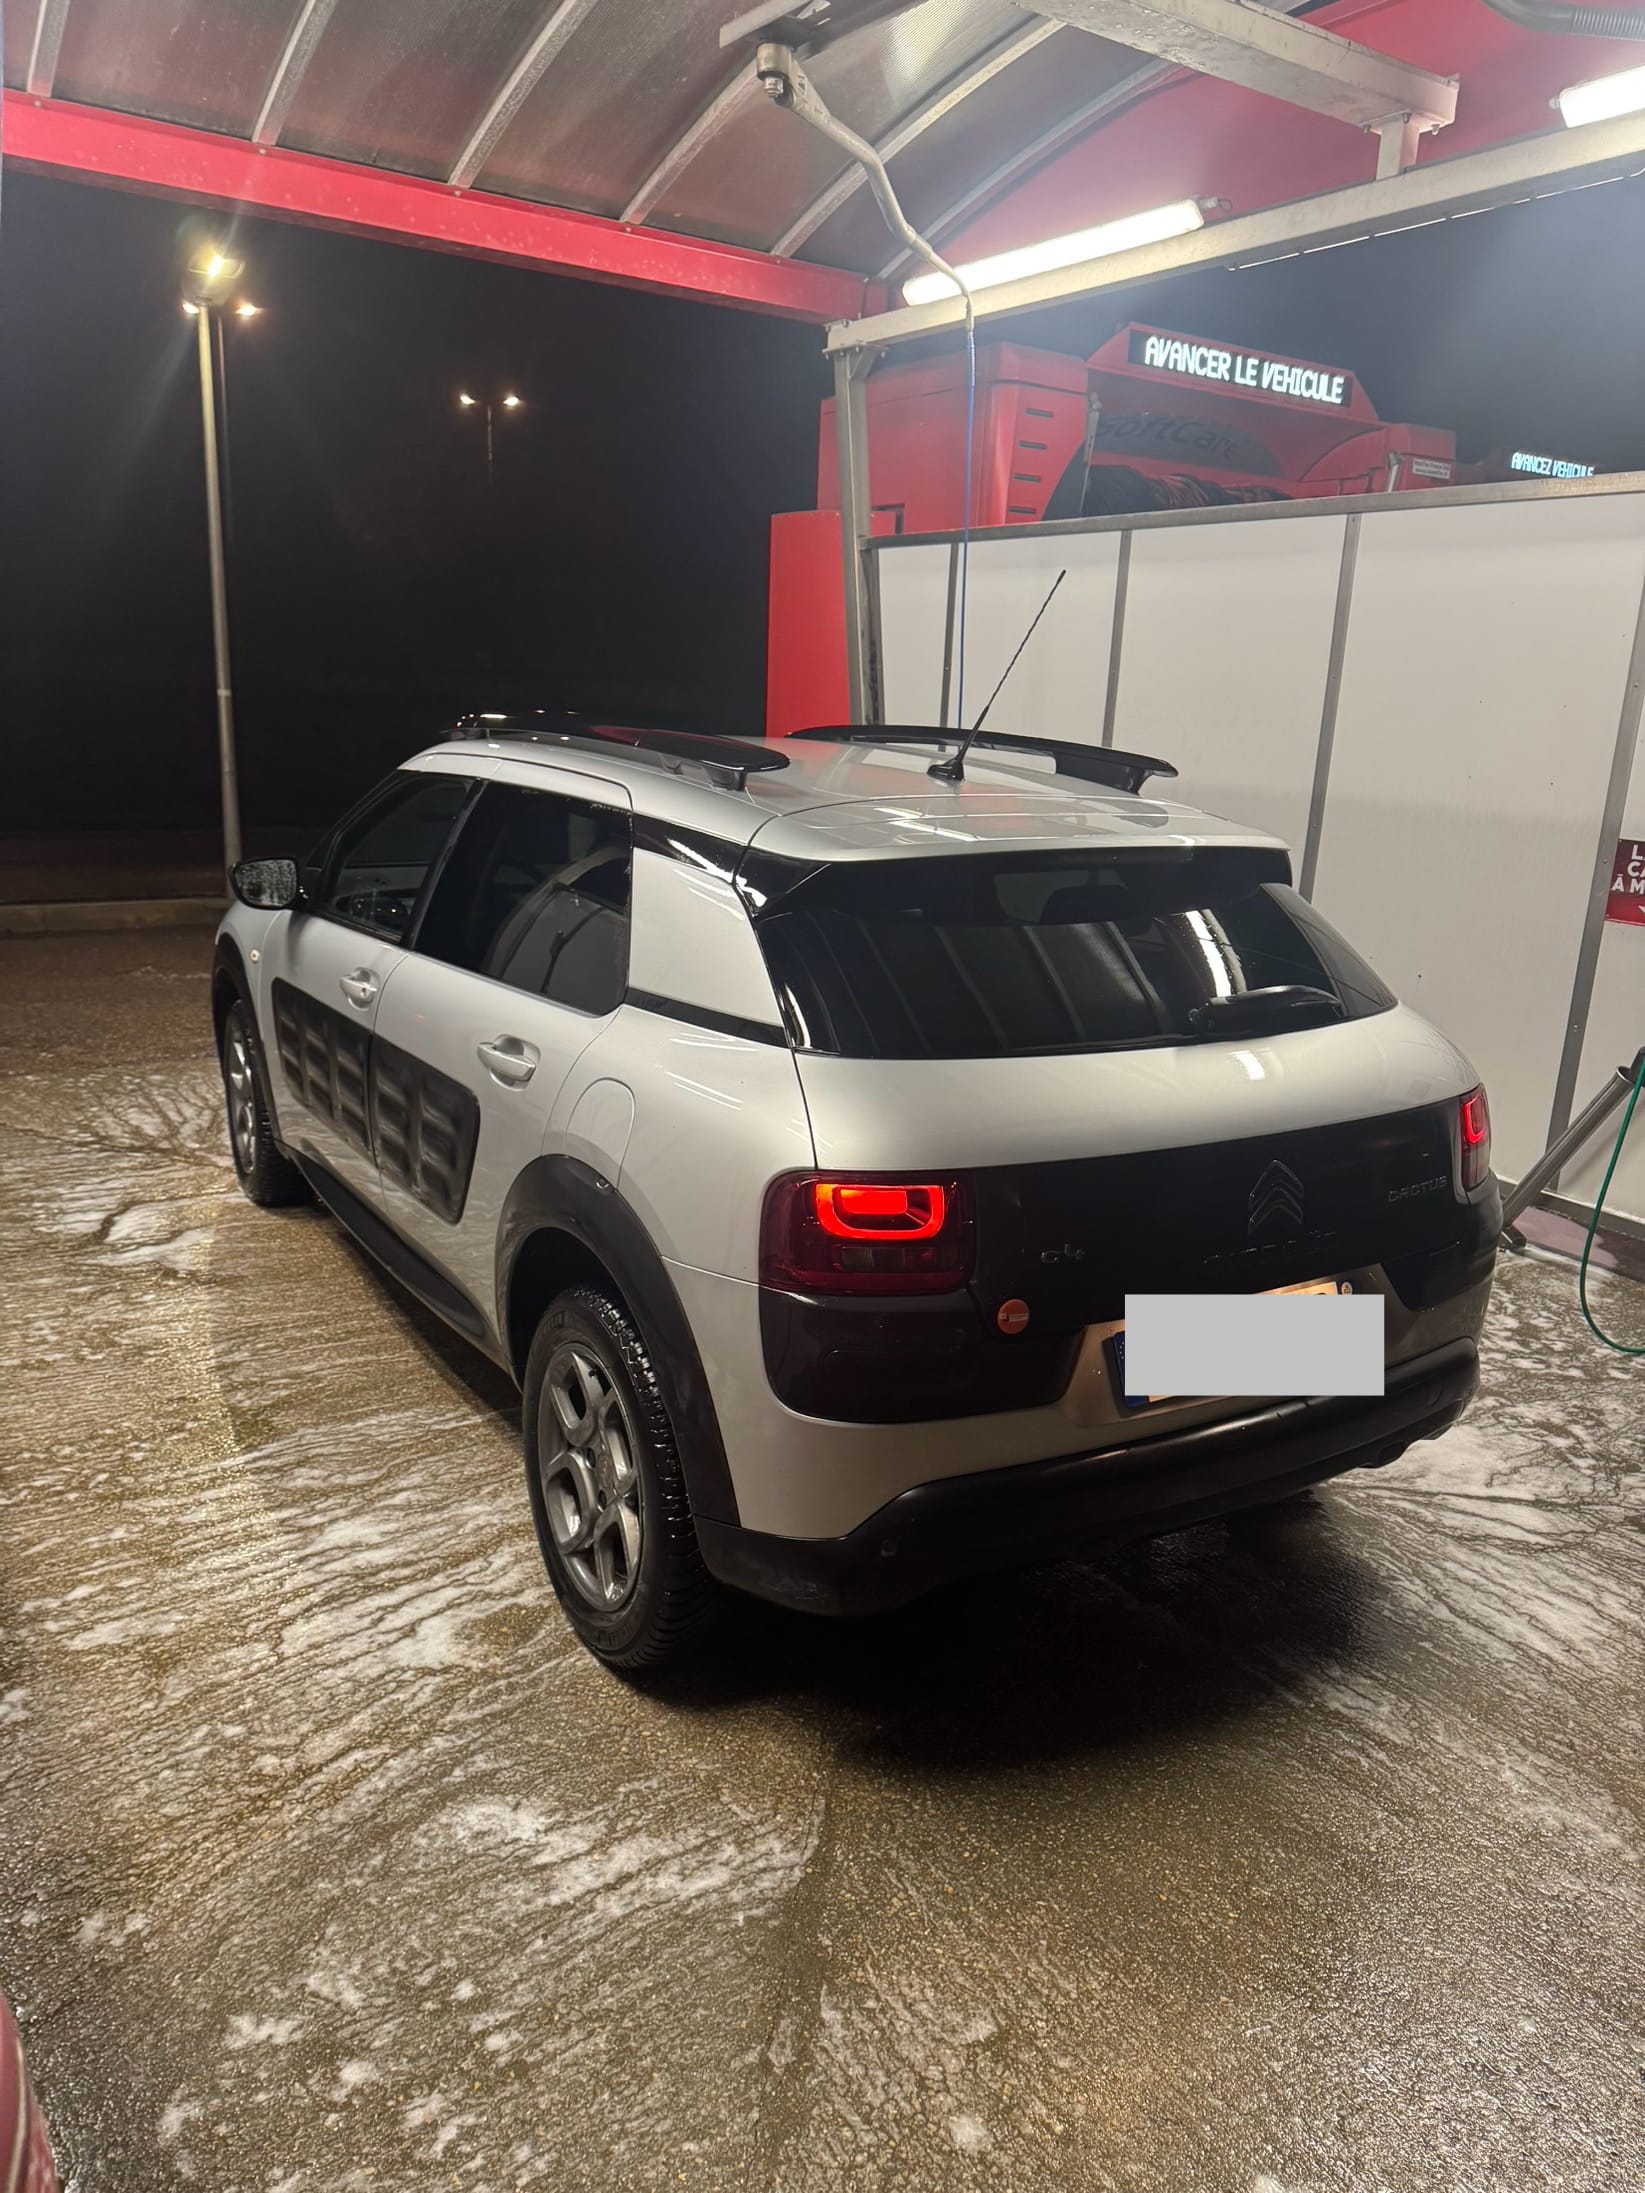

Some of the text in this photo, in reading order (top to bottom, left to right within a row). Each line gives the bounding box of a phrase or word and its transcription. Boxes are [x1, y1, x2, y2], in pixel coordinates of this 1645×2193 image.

[1144, 335, 1345, 404] AVANCER LE VEHICULE
[1511, 452, 1553, 476] AVANCEZ
